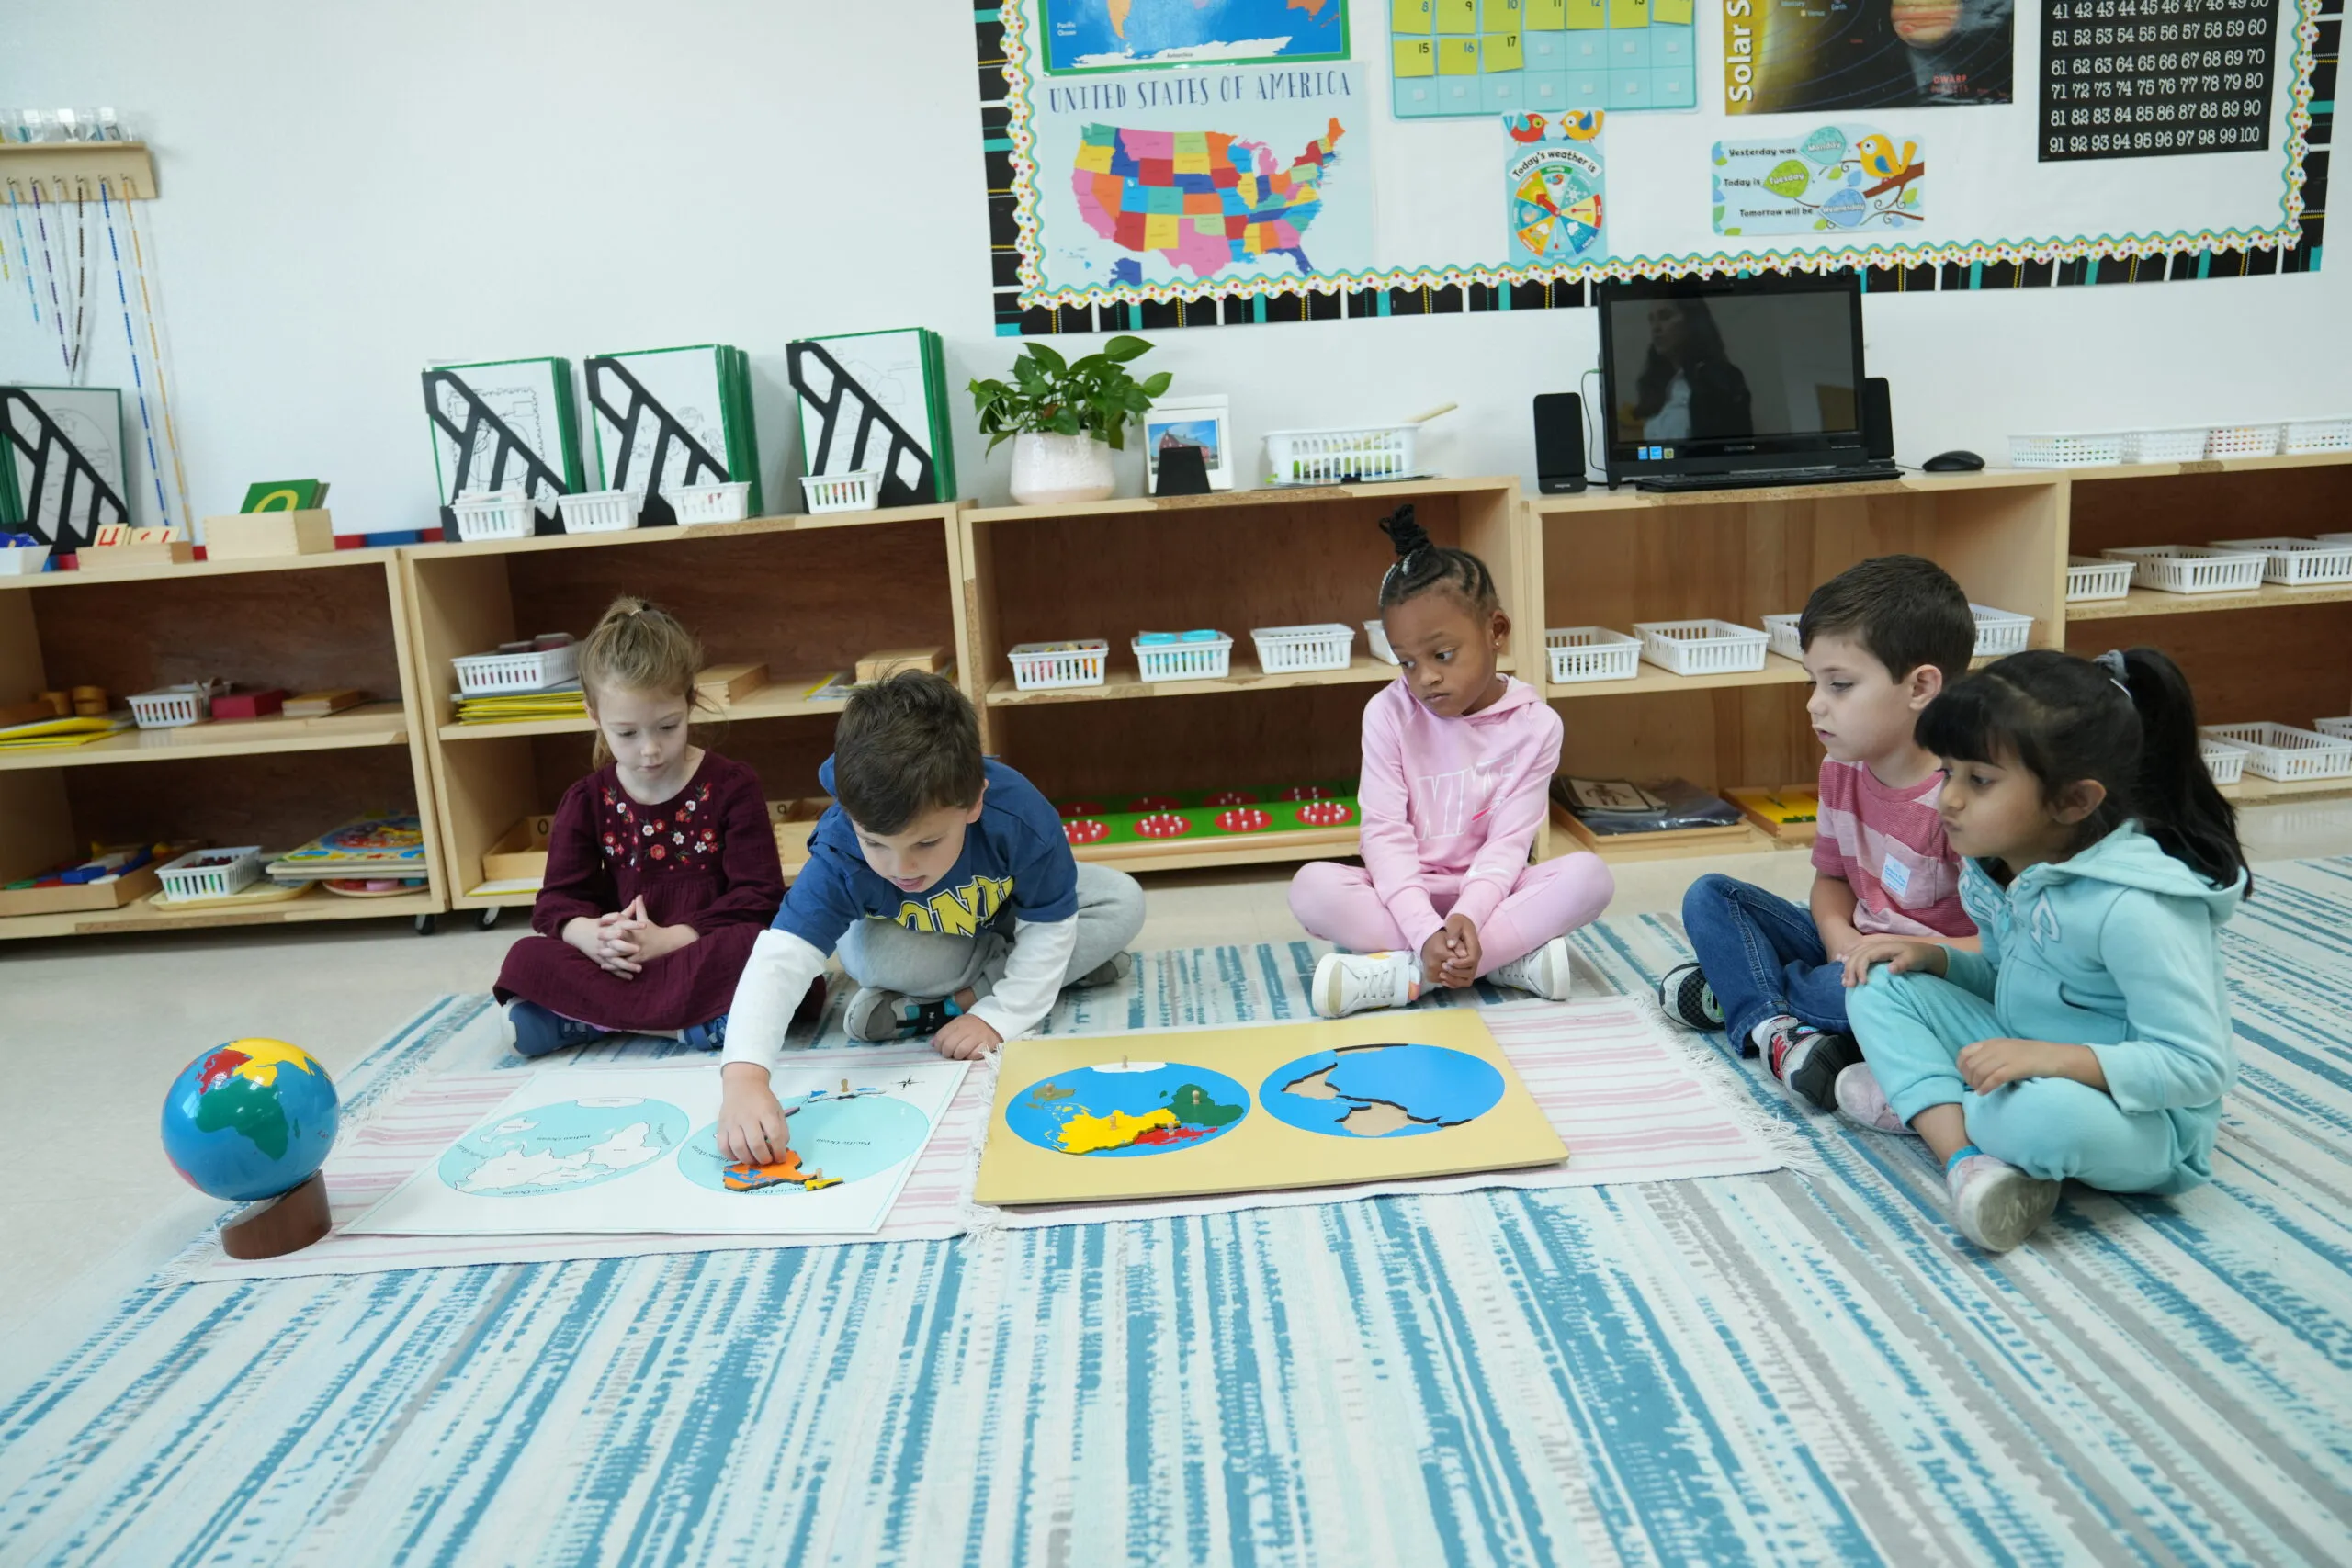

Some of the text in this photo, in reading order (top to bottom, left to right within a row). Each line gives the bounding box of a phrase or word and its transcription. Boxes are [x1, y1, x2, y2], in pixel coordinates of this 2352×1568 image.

[2052, 4, 2069, 19] 41
[2075, 2, 2092, 18] 42
[2097, 1, 2114, 17] 43
[2118, 0, 2136, 16] 44
[2140, 0, 2158, 15] 45
[2161, 0, 2179, 13] 46
[2184, 0, 2202, 12] 47
[1419, 36, 1517, 53] 15 16 17
[2052, 18, 2266, 47] 51 52 53 54 55 56 57 58 59 60
[1727, 23, 1753, 102] Solar
[2052, 48, 2265, 75] 61 62 63 64 65 66 67 68 69 70
[1049, 70, 1351, 114] UNITED STATES OF AMERICA
[2052, 73, 2263, 99] 71 72 73 74 75 76 77 78 79 80
[2051, 100, 2261, 126] 81 82 83 84 85 86 87 88 89 90
[1729, 147, 1776, 157] Yesterday
[1807, 141, 1841, 152] Monday
[2050, 126, 2259, 152] 91 92 93 94 95 96 97 98 99 100
[1512, 151, 1596, 177] Today's weather is
[1724, 179, 1750, 187] Today
[1770, 172, 1804, 185] Tuesday
[1740, 209, 1782, 218] Tomorrow
[1785, 208, 1800, 216] will
